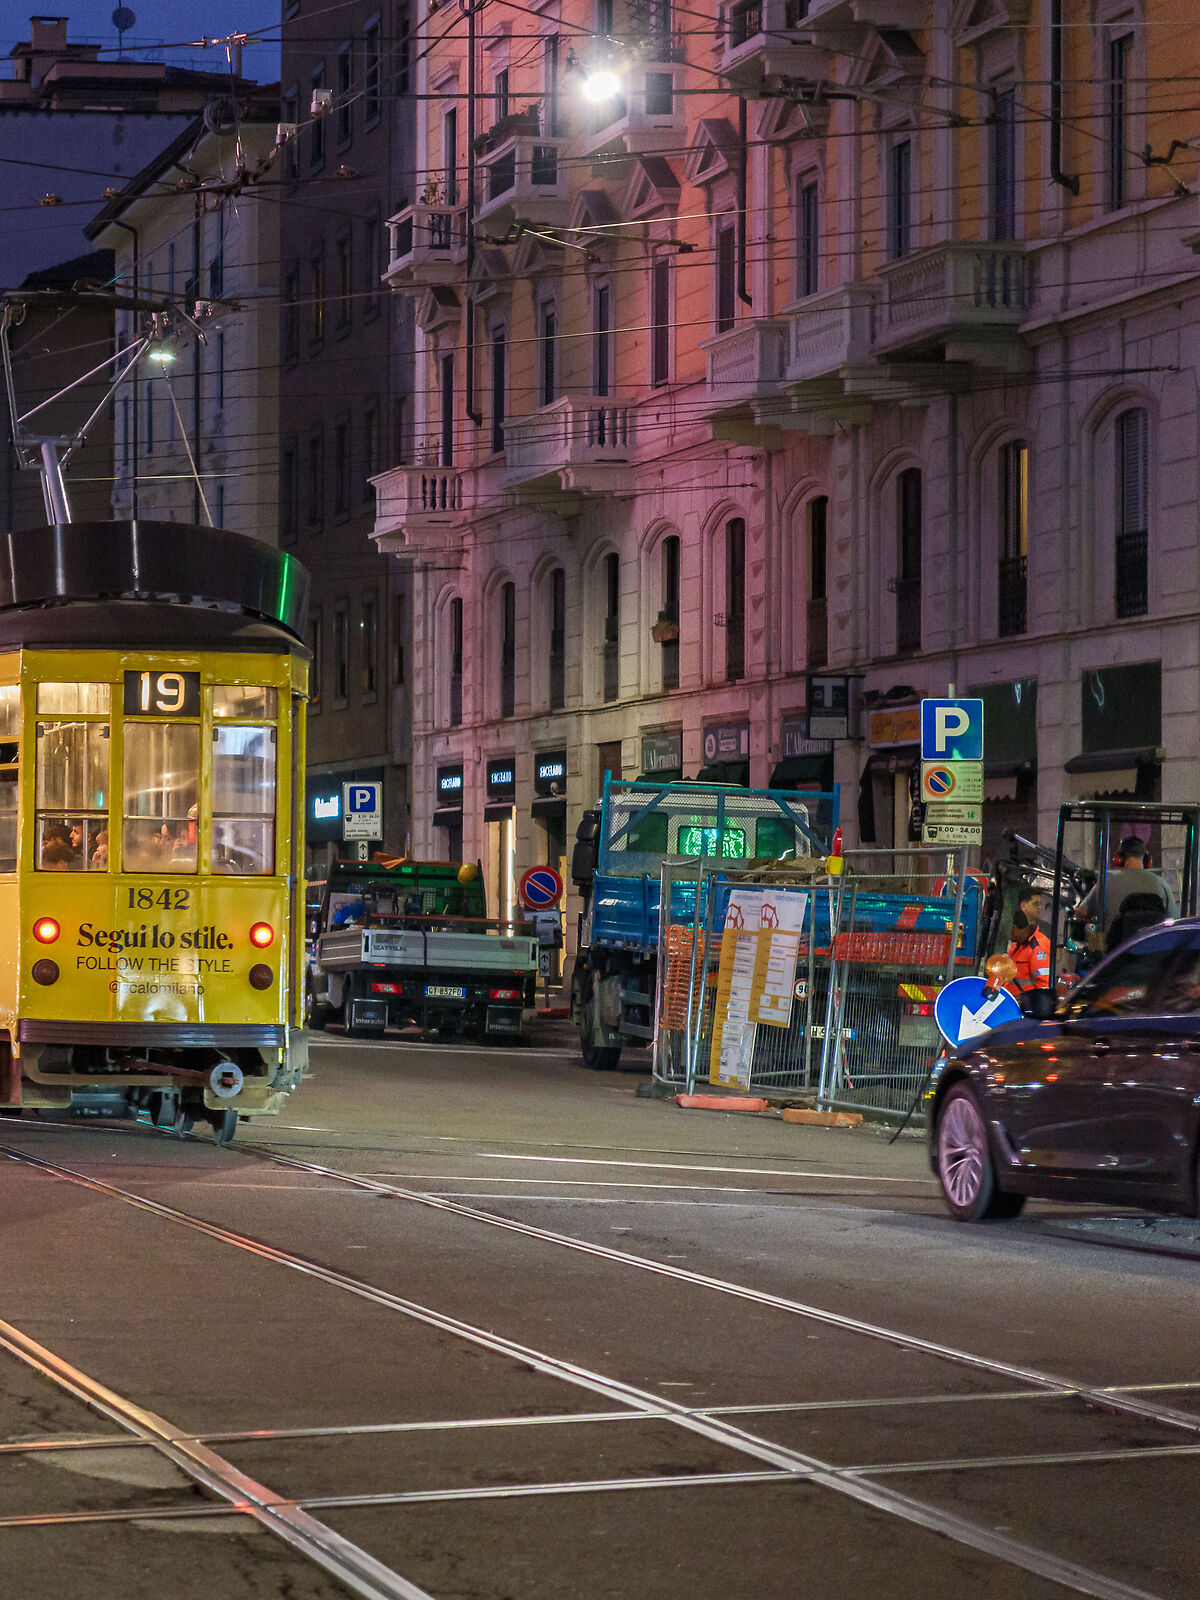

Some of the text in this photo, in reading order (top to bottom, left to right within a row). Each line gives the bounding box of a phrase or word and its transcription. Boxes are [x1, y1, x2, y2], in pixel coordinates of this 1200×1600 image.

[141, 672, 185, 711] 19
[812, 678, 845, 707] T
[935, 707, 970, 752] P
[356, 790, 371, 810] P
[128, 888, 191, 911] 1842
[77, 923, 234, 954] Segui lo stile.
[76, 956, 234, 973] FOLLOW THE STYLE.
[355, 1017, 385, 1025] Interauto
[489, 1023, 519, 1032] Interauto
